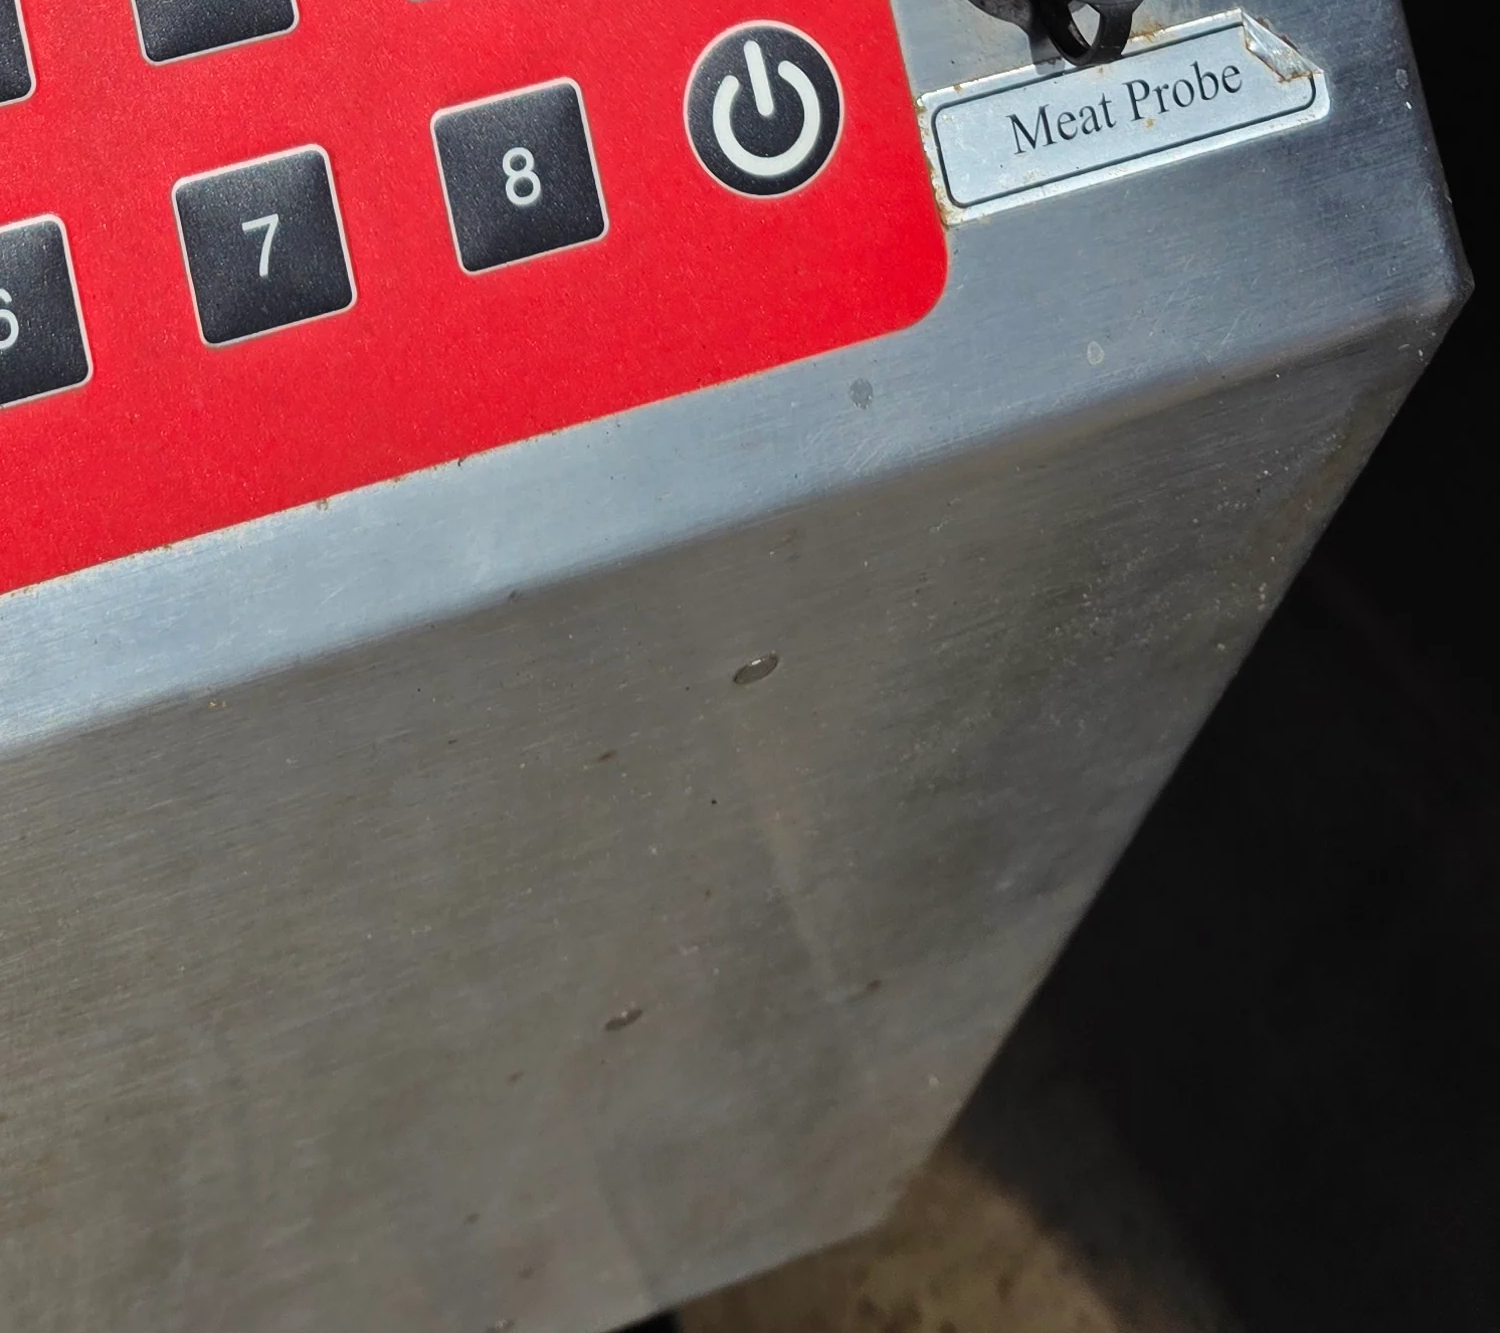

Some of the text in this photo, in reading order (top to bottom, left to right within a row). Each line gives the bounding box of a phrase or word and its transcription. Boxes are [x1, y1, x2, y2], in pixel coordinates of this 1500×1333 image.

[1008, 61, 1243, 156] Meat Probe
[503, 148, 541, 206] 8
[242, 214, 279, 277] 7
